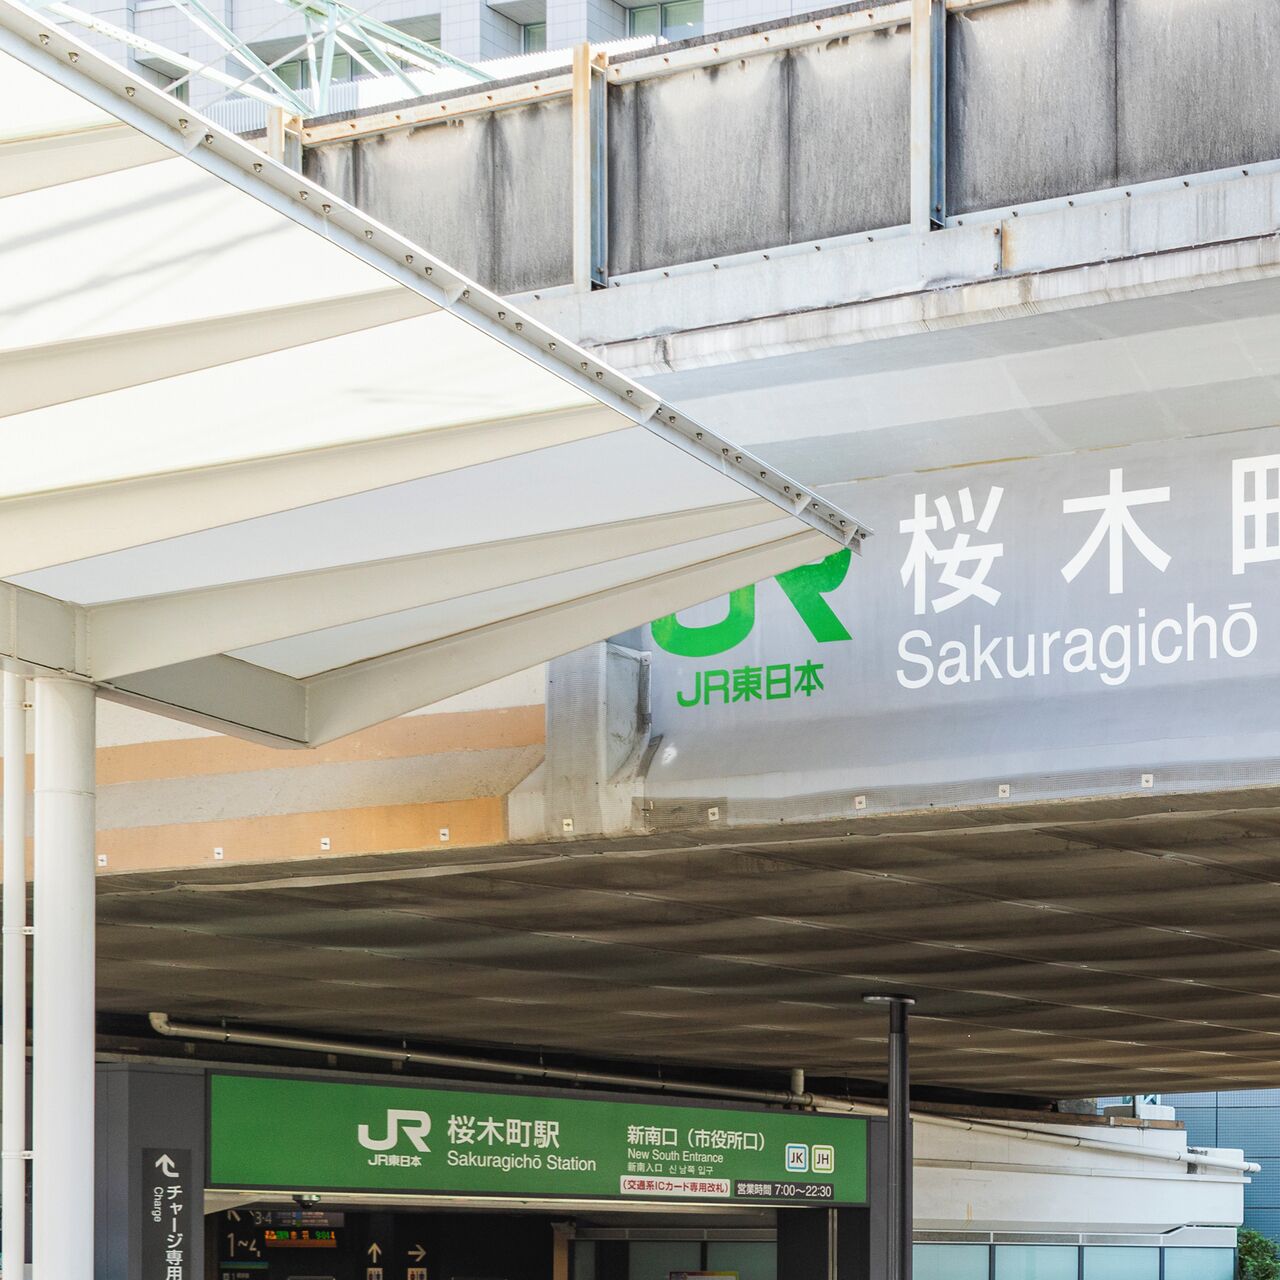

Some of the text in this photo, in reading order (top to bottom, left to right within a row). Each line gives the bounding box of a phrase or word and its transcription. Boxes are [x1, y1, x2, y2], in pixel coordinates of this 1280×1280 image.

[896, 600, 1259, 691] Sakuragichō
[676, 659, 825, 708] JR東日本
[358, 1108, 432, 1153] JR
[447, 1114, 560, 1149] 桜木町駅
[368, 1154, 422, 1168] JR東日本
[447, 1150, 597, 1172] Sakuragichō Station
[628, 1148, 724, 1163] New South Entrance
[790, 1151, 804, 1165] JK
[816, 1152, 830, 1166] JH
[627, 1162, 663, 1173] 新南入口
[737, 1183, 772, 1196] 営業時間
[151, 1186, 164, 1223] Charge
